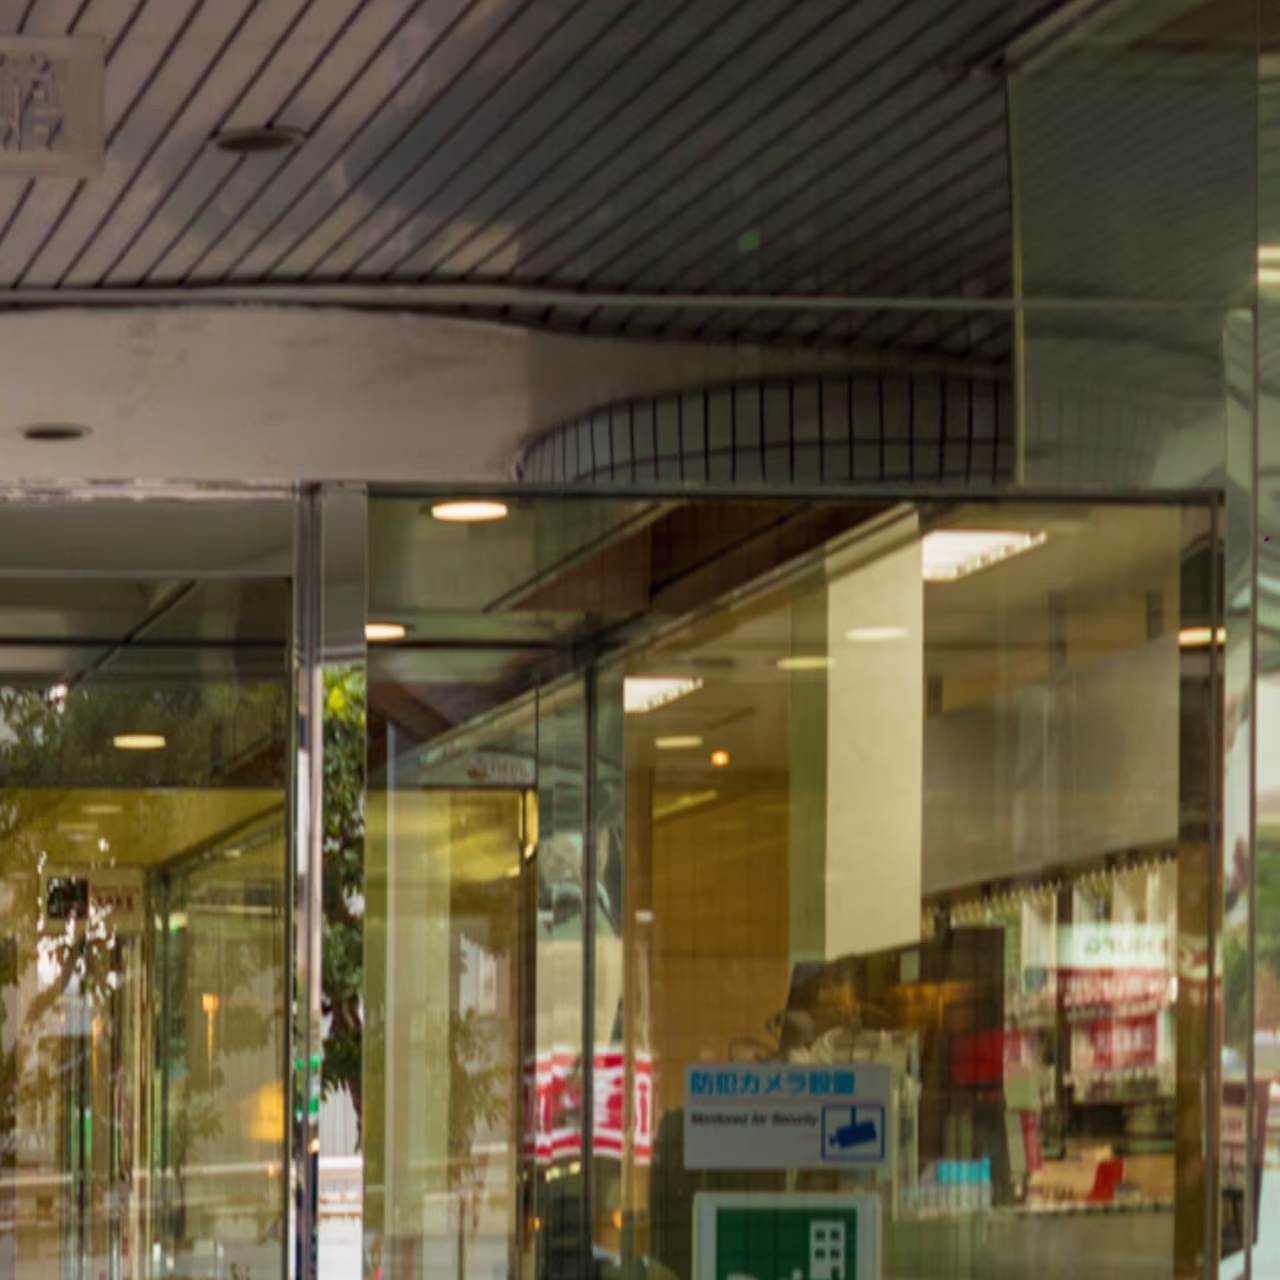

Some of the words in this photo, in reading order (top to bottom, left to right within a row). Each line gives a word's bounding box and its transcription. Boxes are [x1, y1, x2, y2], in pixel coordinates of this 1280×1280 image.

[691, 1071, 855, 1095] 防犯カメラ設置
